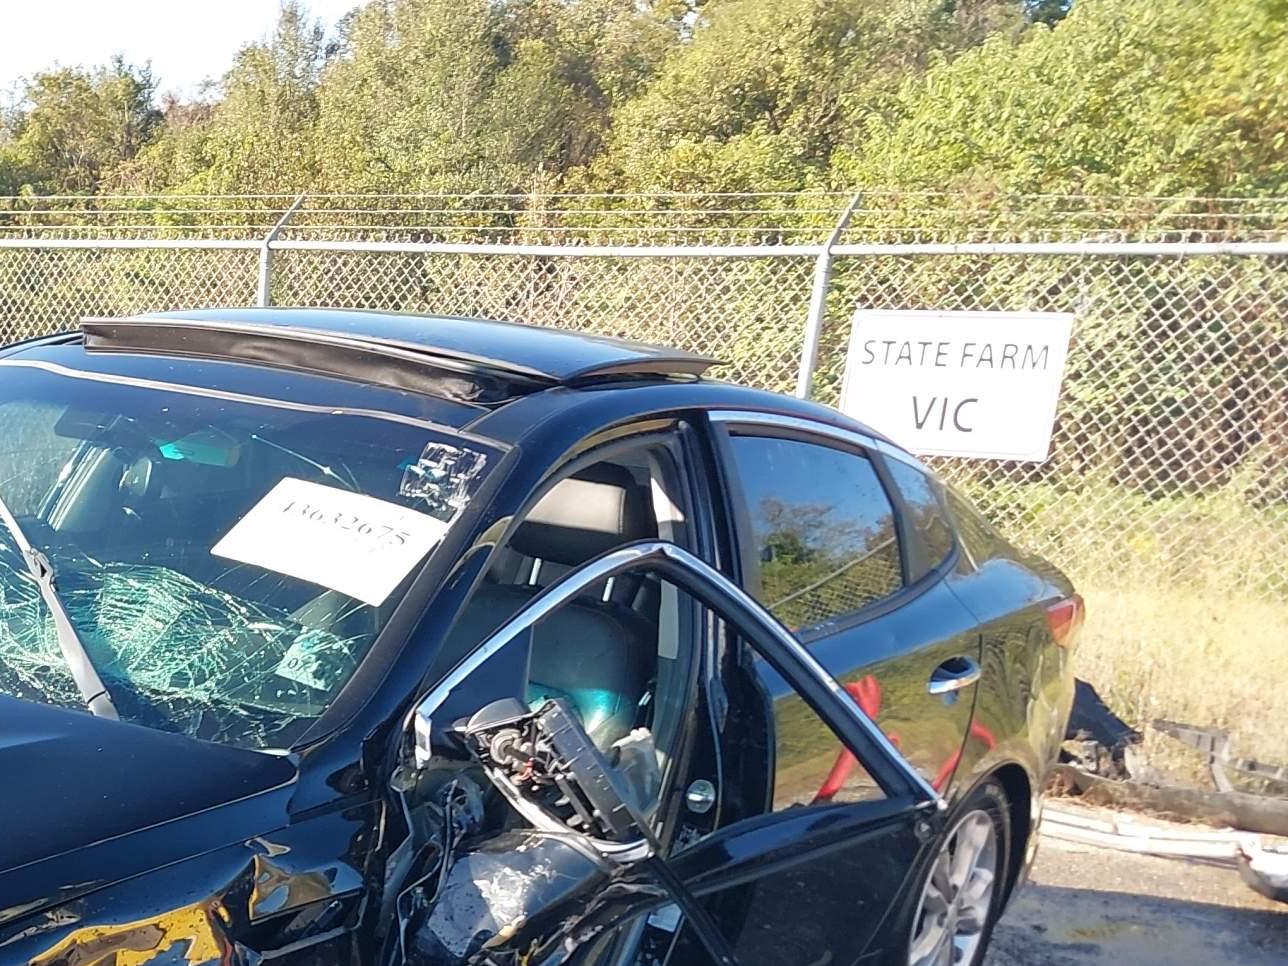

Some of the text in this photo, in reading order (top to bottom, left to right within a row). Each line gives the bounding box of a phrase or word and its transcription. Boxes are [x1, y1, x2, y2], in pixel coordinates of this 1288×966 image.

[861, 339, 1050, 370] STATE FARM
[912, 395, 979, 433] VIC
